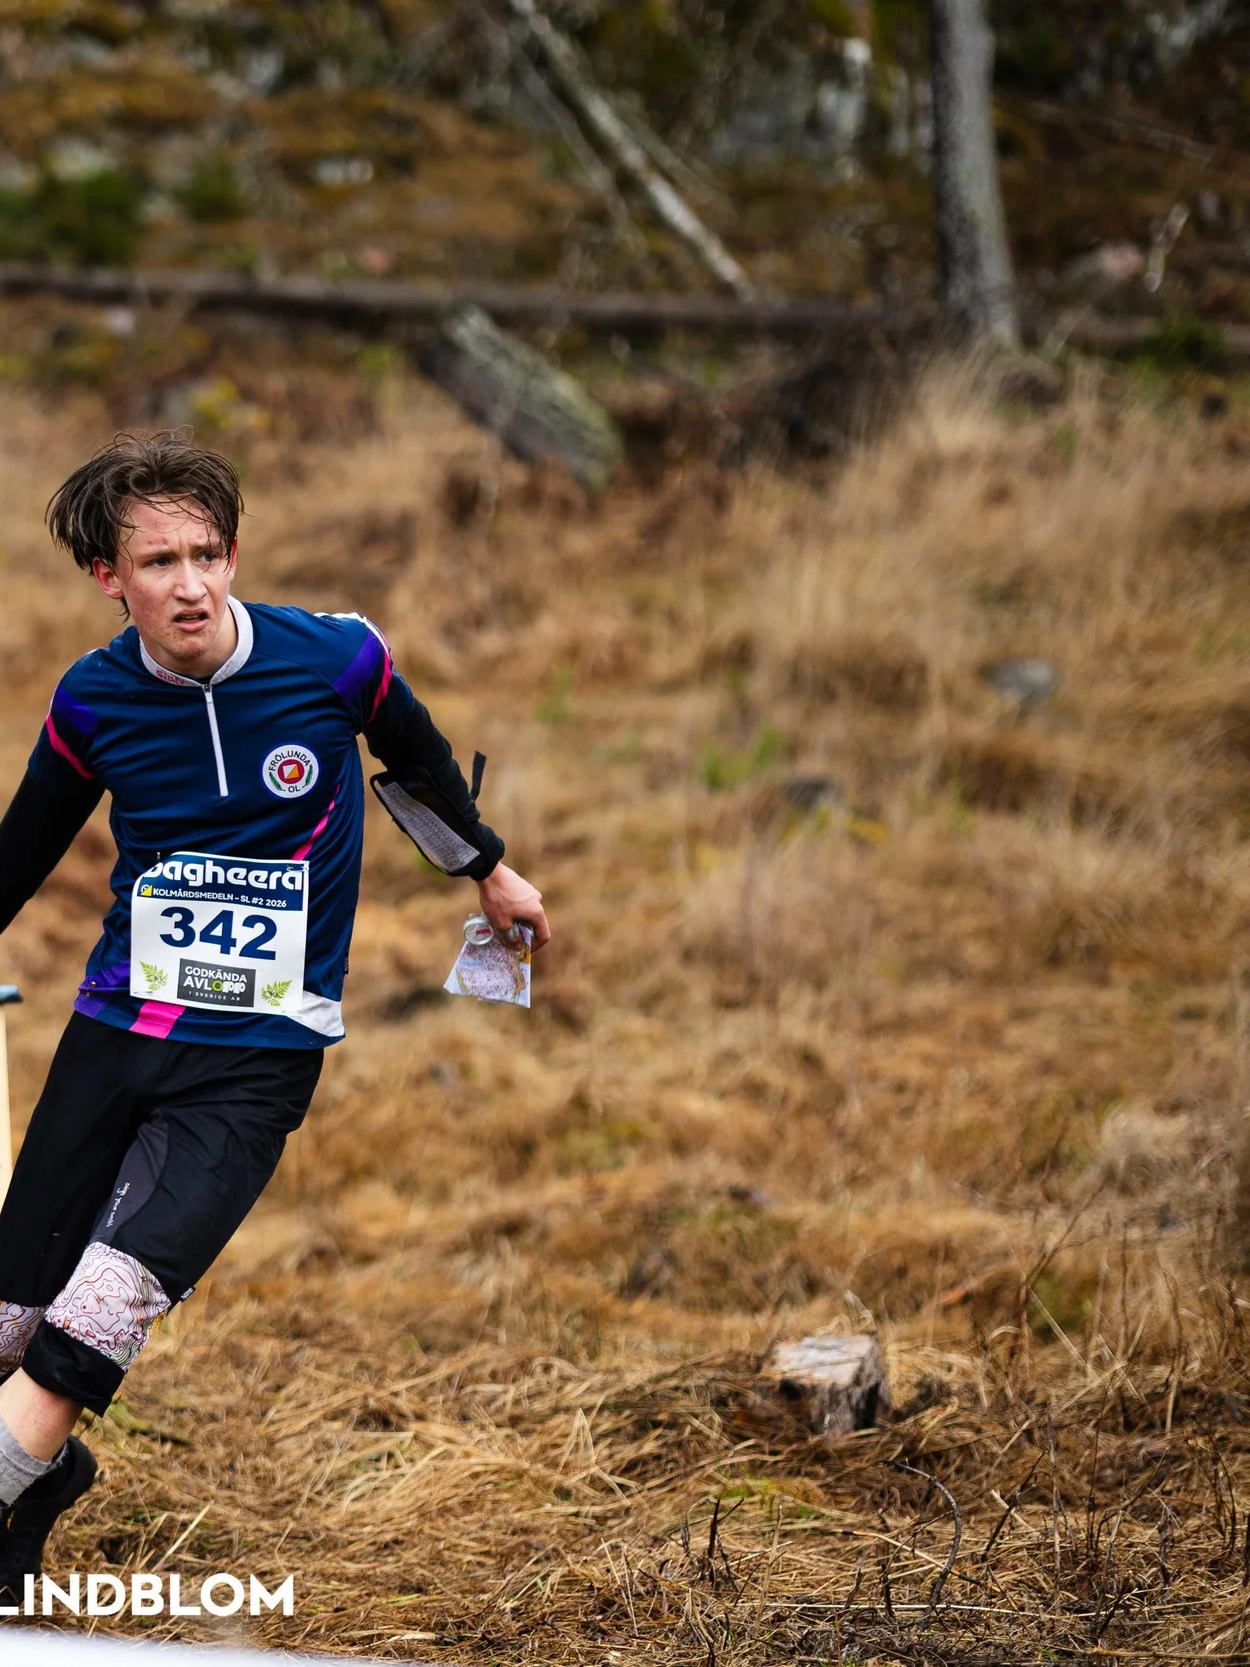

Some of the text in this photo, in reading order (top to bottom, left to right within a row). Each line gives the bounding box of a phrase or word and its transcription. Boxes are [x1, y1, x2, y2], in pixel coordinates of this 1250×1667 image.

[268, 750, 310, 771] FRÖLUNDA
[287, 785, 301, 793] OL
[152, 887, 234, 902] KOLMÅRDSMEDELN
[240, 894, 251, 903] SL
[251, 896, 264, 906] #2
[265, 898, 287, 908] 2026
[159, 906, 278, 961] 342
[184, 965, 248, 983] GODKÄNDA
[195, 991, 227, 1000] SVERIGE
